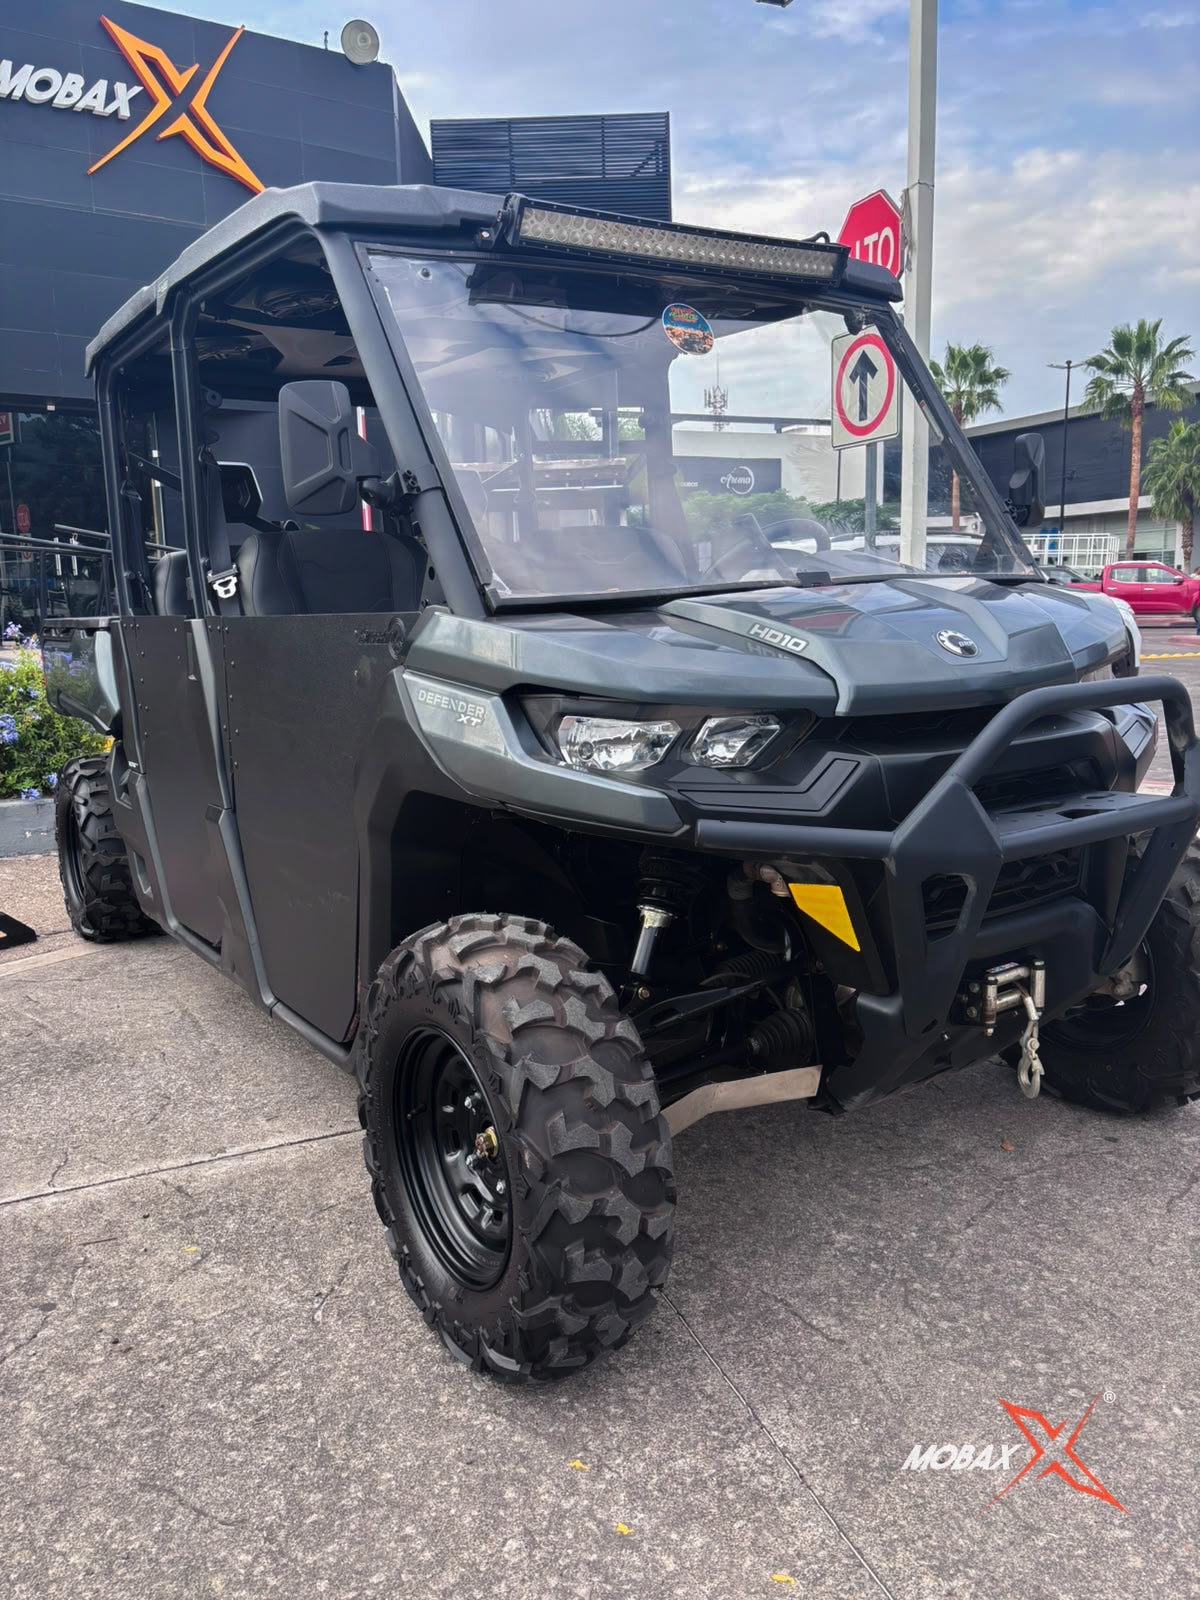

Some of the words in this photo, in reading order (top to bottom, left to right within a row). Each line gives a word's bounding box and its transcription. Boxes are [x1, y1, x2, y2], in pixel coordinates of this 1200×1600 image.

[0, 59, 144, 120] MOBAX
[848, 226, 895, 270] TO
[748, 623, 807, 652] HD10
[418, 689, 485, 718] DEFENDER
[457, 714, 482, 726] XT
